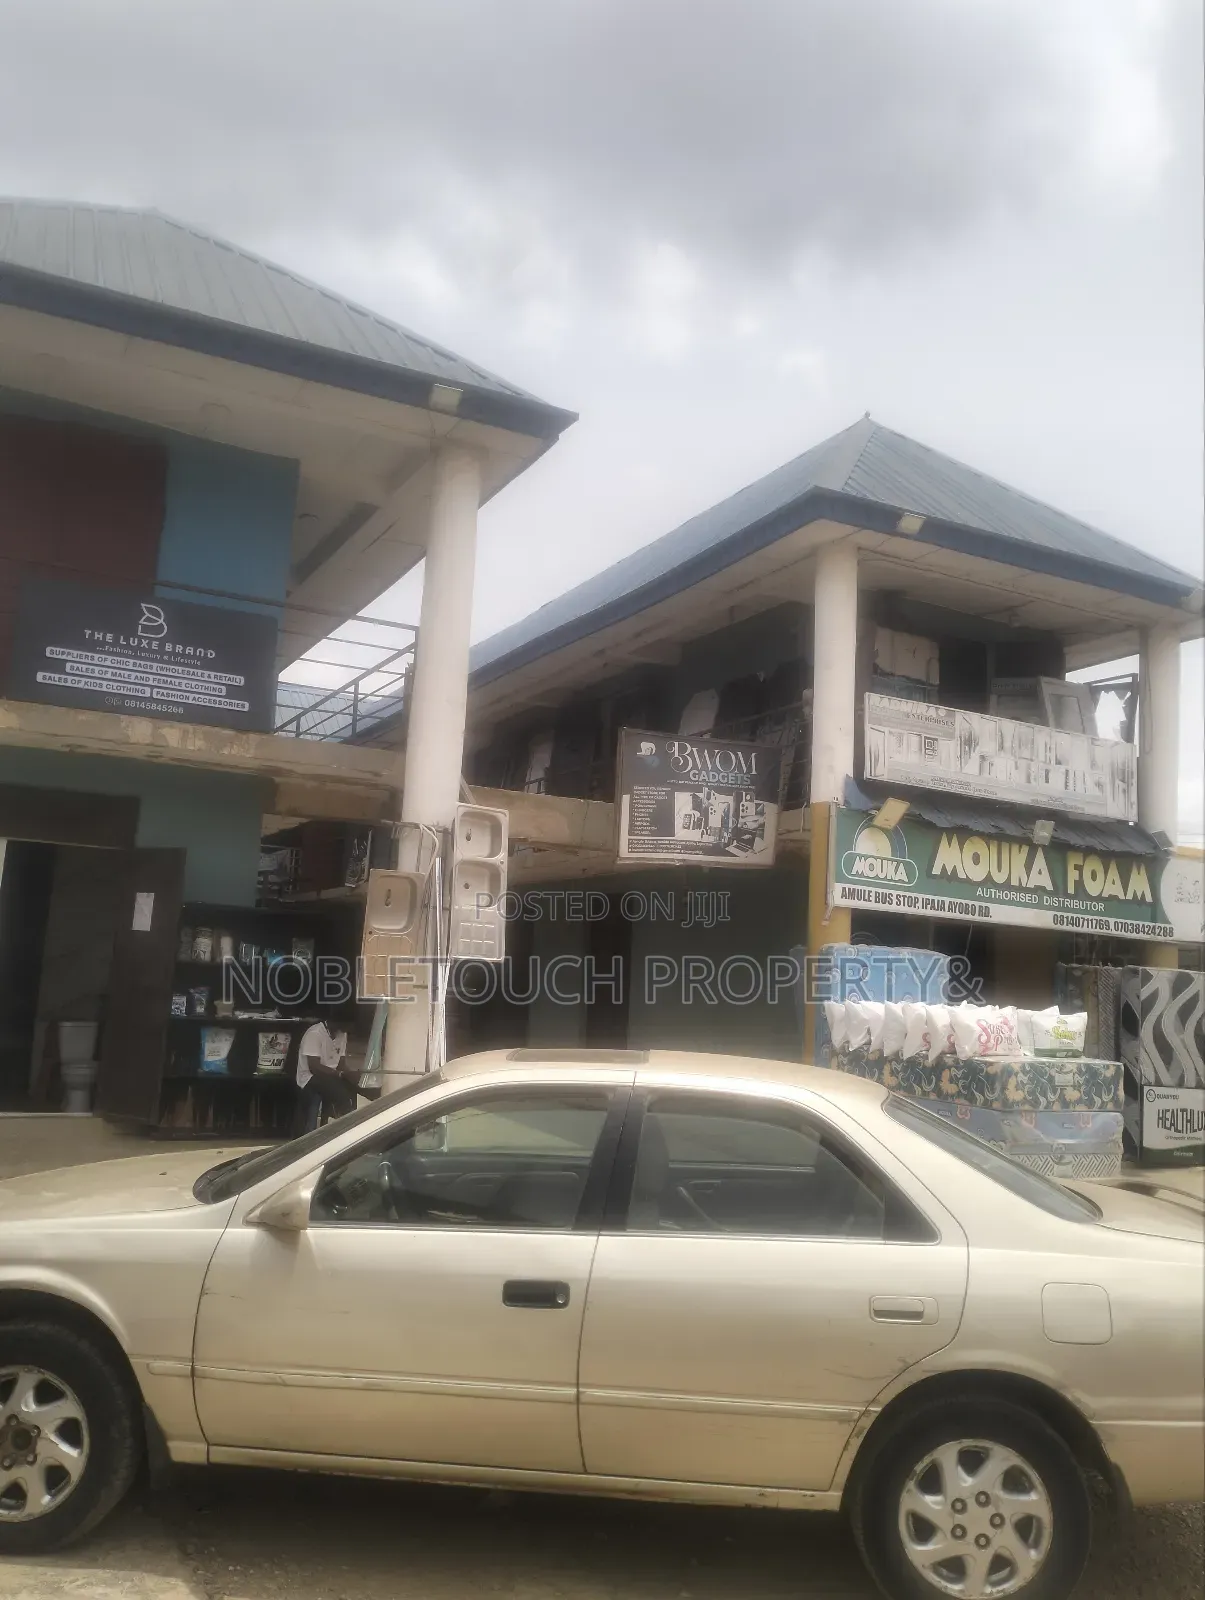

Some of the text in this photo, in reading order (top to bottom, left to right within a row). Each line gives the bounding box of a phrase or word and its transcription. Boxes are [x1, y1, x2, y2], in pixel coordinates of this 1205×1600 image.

[84, 629, 216, 659] THE LUXE BRAND
[49, 650, 95, 662] SUPPLIERS
[110, 658, 131, 667] CHIC
[132, 662, 154, 670] BAGS
[156, 664, 205, 680] (WHOLESALE
[213, 675, 242, 686] RETAIL)
[69, 664, 223, 694] SALES OF MALE AND FEMALE CLOTHING
[41, 674, 146, 696] SALES OF KIDS CLOTHING
[156, 690, 246, 710] FASHION ACCESSORIES
[665, 740, 758, 776] BWOM
[689, 769, 751, 785] GADGETS
[850, 856, 909, 883] MOUKA
[930, 831, 1154, 903] MOUKA FOAM
[840, 886, 993, 919] AMULE BUS STOP, IPAJA AYOBO RD.
[976, 886, 1105, 912] AUTHORISED DISTRIBUTOR
